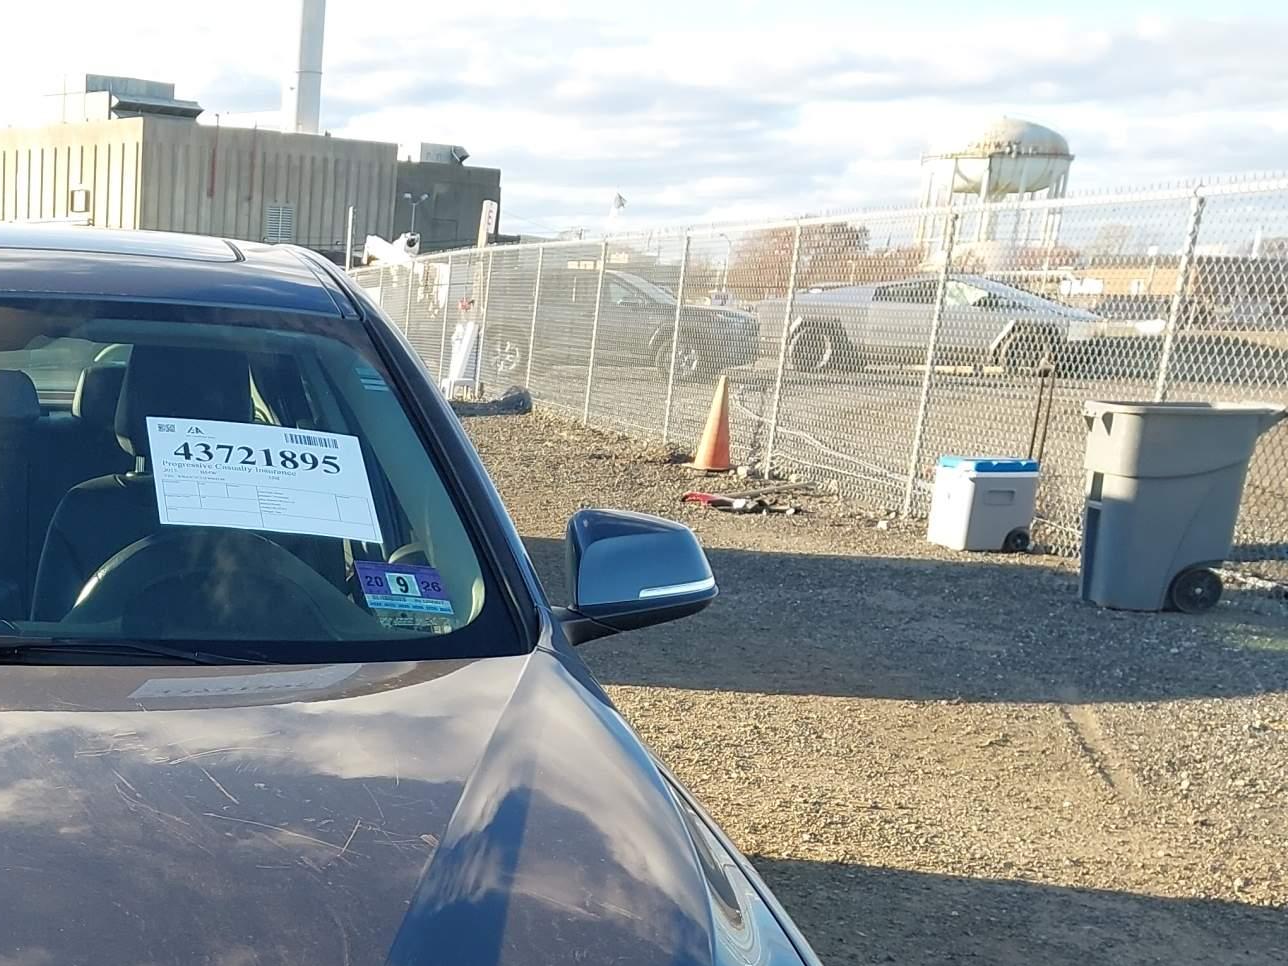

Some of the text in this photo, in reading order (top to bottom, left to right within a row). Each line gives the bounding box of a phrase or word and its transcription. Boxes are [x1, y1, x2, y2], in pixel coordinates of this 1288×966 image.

[173, 441, 341, 475] 43721895
[162, 459, 213, 469] Progressive
[215, 463, 252, 473] Casualty
[255, 466, 297, 477] Insurance
[365, 575, 442, 594] 20 9 26
